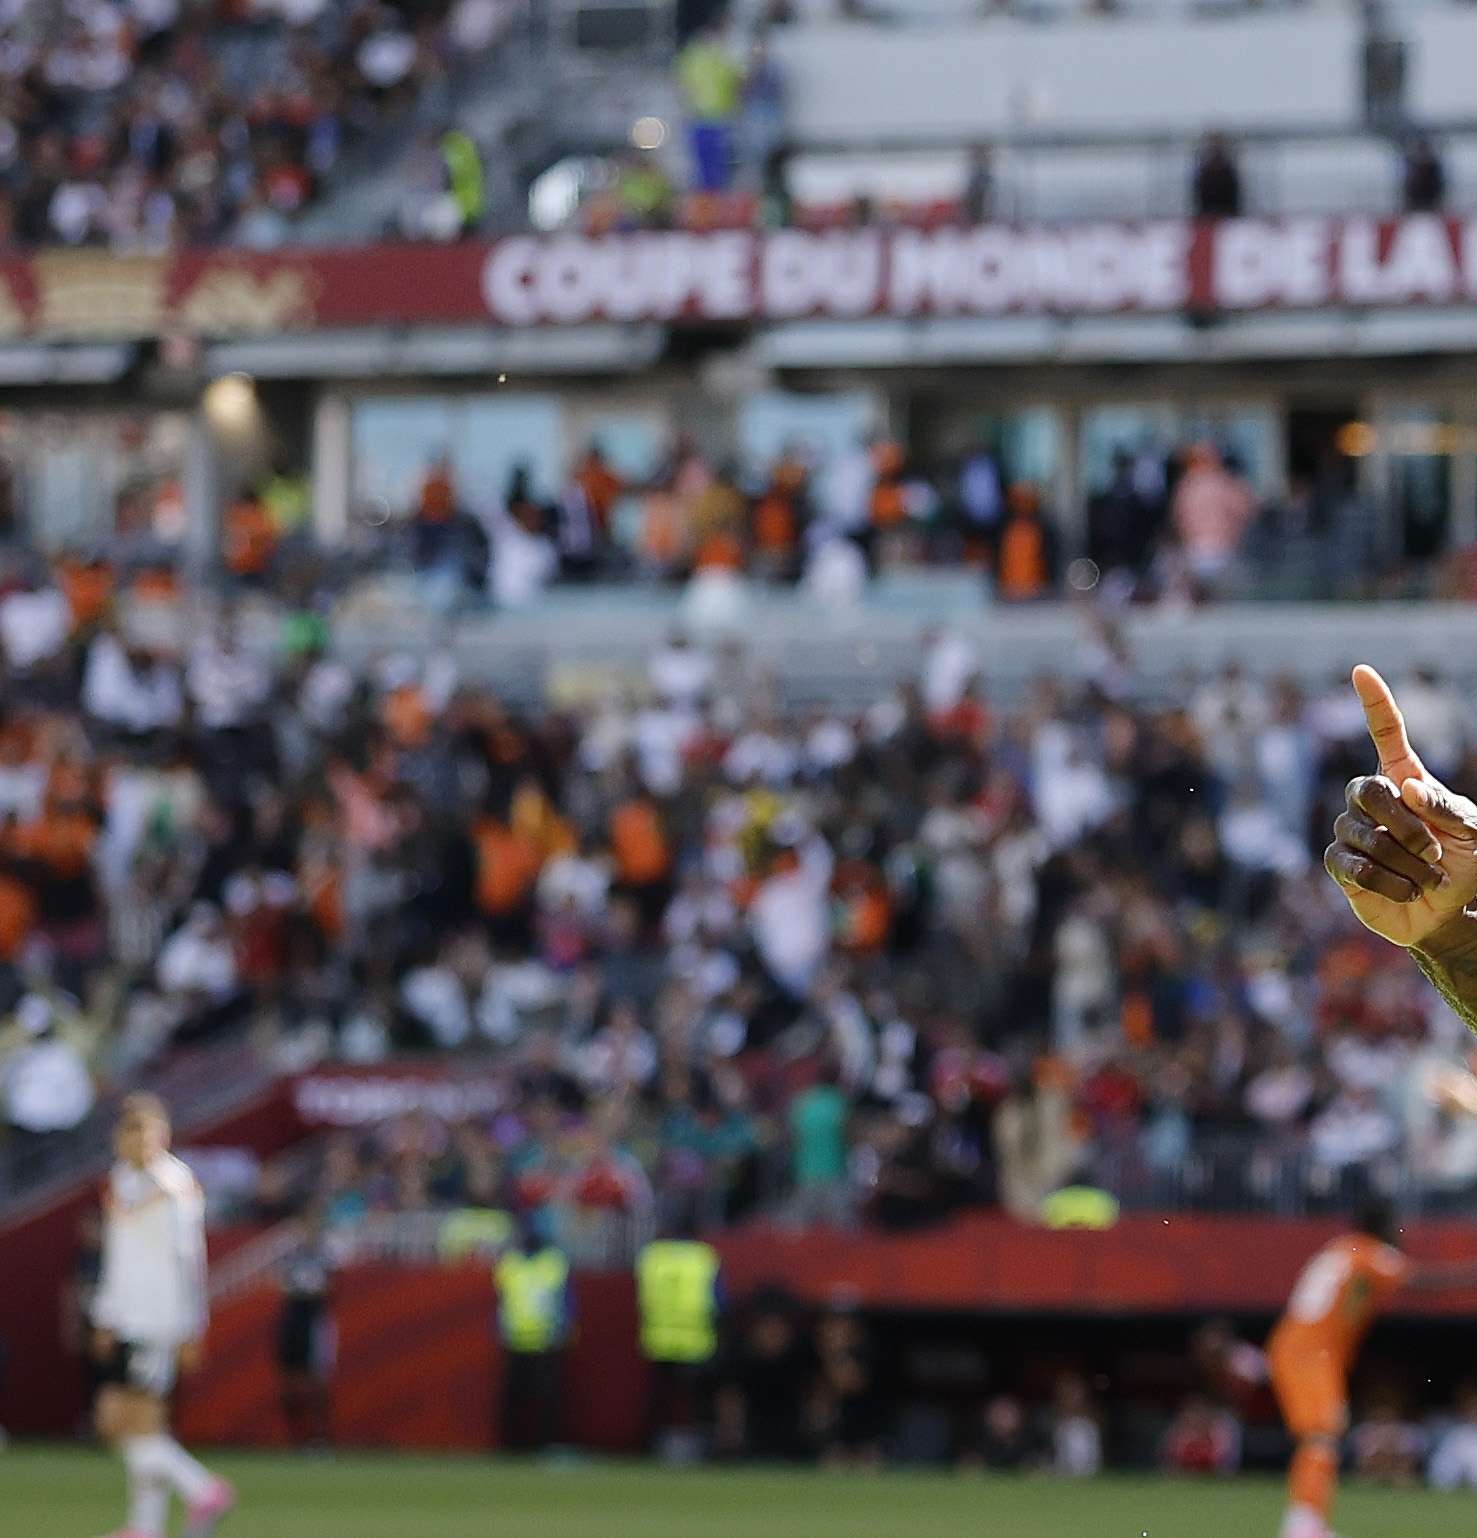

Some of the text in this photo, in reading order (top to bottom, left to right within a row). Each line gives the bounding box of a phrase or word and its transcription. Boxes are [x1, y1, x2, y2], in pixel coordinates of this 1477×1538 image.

[483, 231, 752, 323] COUPE
[758, 227, 880, 319] DU
[888, 221, 1186, 316] MONDE
[1209, 215, 1328, 309] DE
[1334, 211, 1453, 304] LA
